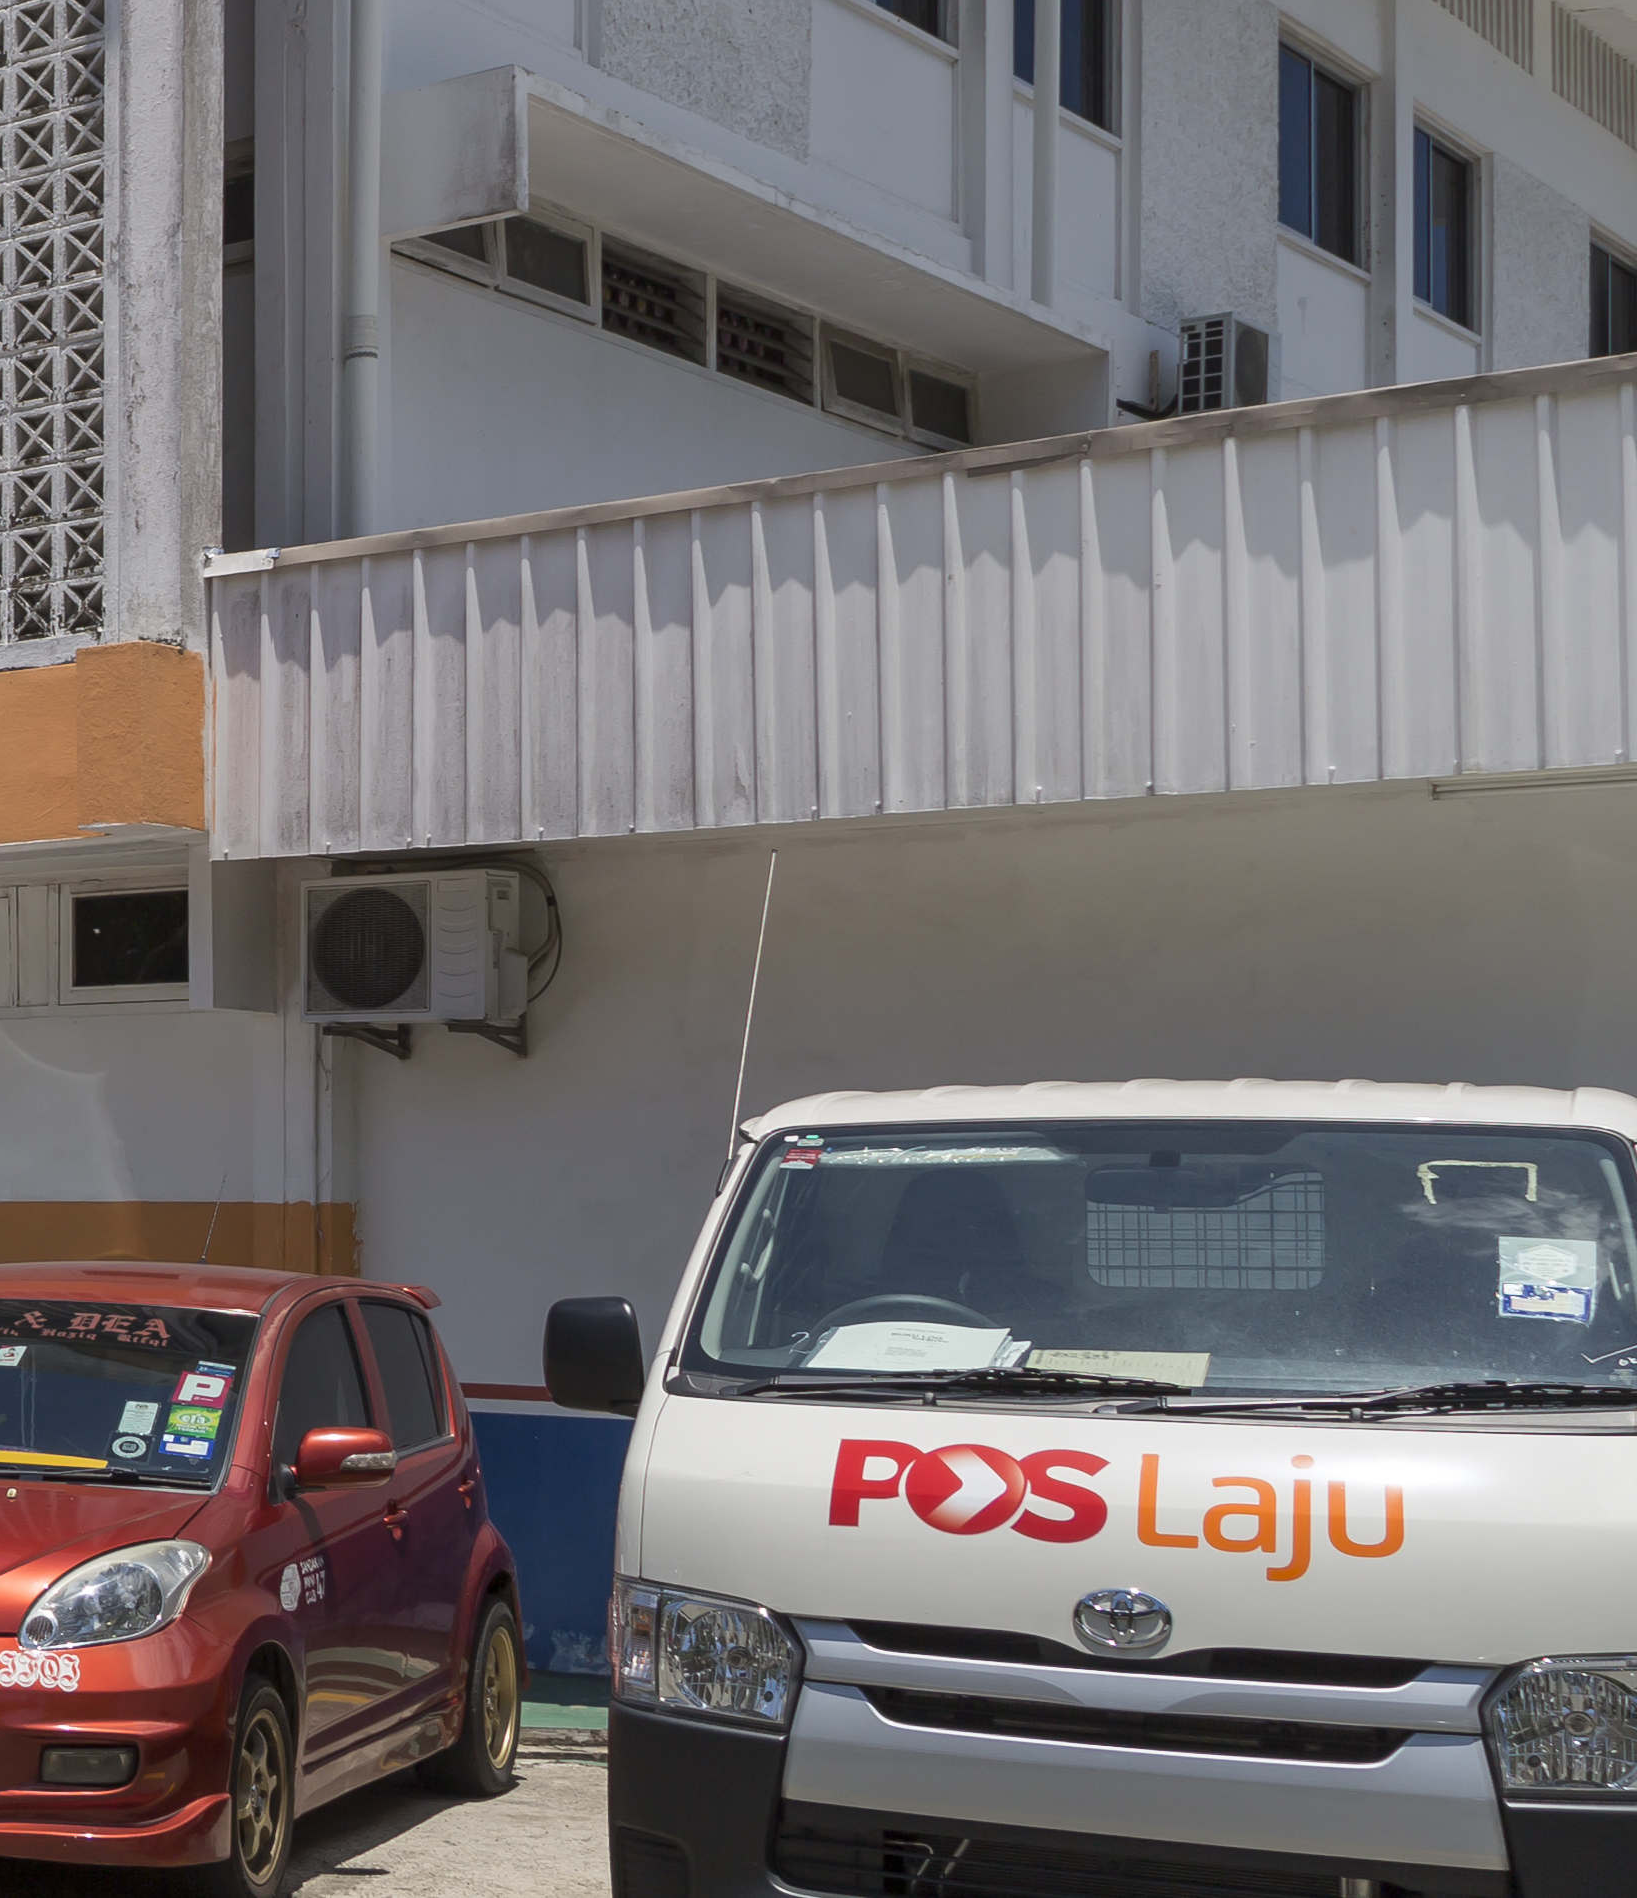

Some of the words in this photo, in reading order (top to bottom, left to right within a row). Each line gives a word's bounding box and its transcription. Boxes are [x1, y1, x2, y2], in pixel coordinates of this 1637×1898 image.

[181, 1413, 207, 1425] era
[828, 1438, 1111, 1544] POS
[1137, 1453, 1405, 1582] Laju
